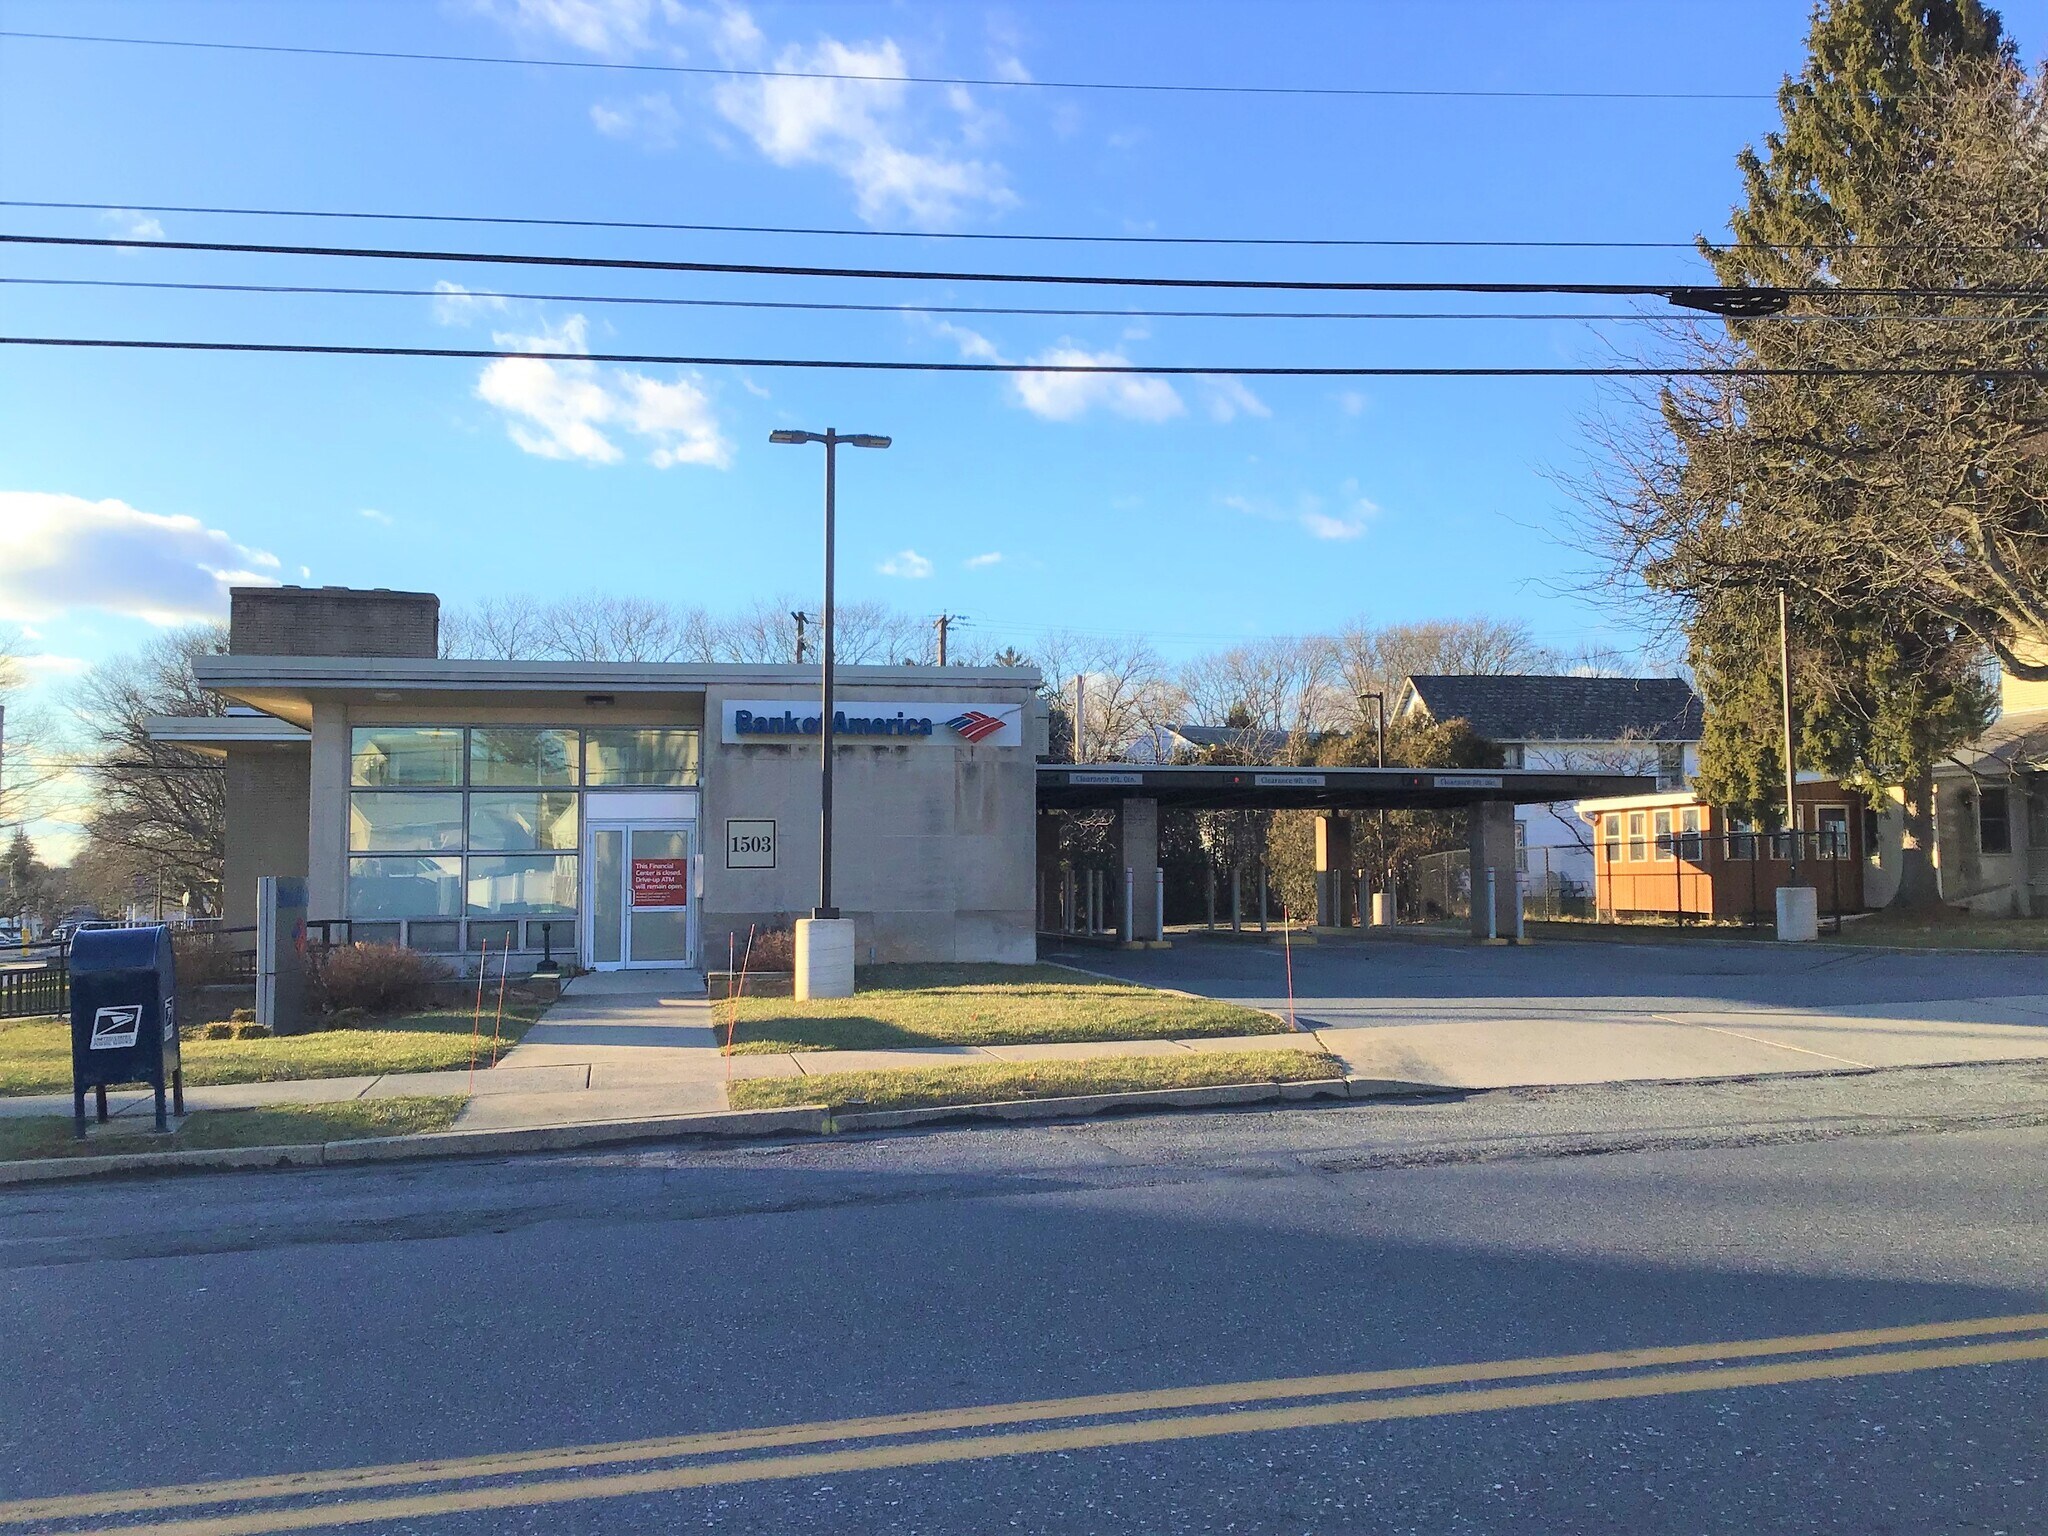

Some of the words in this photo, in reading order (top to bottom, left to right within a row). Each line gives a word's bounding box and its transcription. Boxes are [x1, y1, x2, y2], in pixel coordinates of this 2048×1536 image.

[736, 710, 799, 735] Bank
[832, 710, 932, 736] America
[731, 836, 771, 852] 1503
